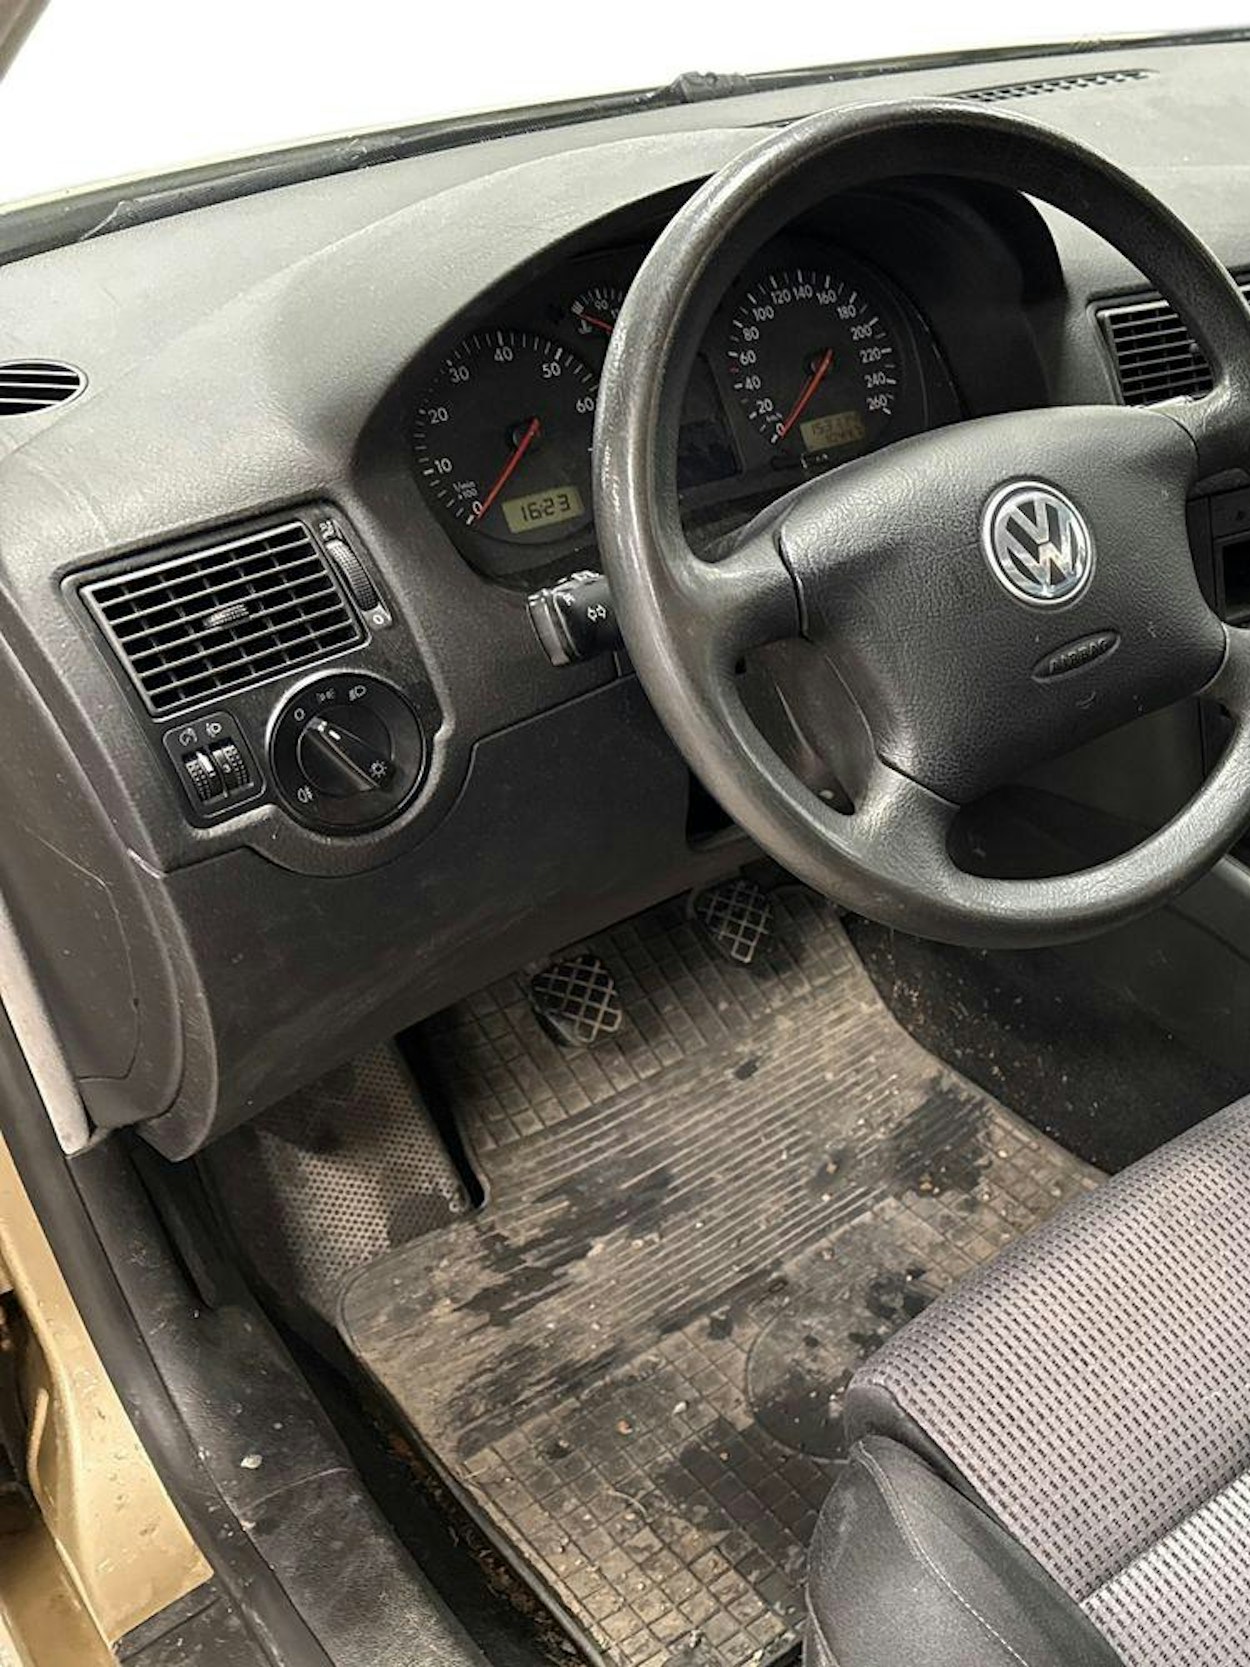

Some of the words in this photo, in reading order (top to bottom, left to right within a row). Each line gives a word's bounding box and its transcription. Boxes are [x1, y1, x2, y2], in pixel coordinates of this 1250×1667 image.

[771, 289, 792, 305] 120
[792, 285, 814, 301] 140
[816, 289, 837, 305] 160
[752, 304, 775, 322] 100
[837, 304, 857, 320] 180
[743, 325, 760, 341] 80
[851, 323, 873, 341] 200
[493, 346, 514, 363] 40
[739, 350, 757, 366] 60
[859, 348, 882, 364] 220
[450, 364, 470, 384] 30
[542, 362, 562, 379] 50
[743, 375, 761, 392] 40
[864, 371, 887, 388] 240
[575, 399, 595, 414] 60
[755, 397, 774, 415] 20
[865, 395, 889, 411] 260
[427, 406, 449, 425] 20
[434, 457, 453, 475] 10
